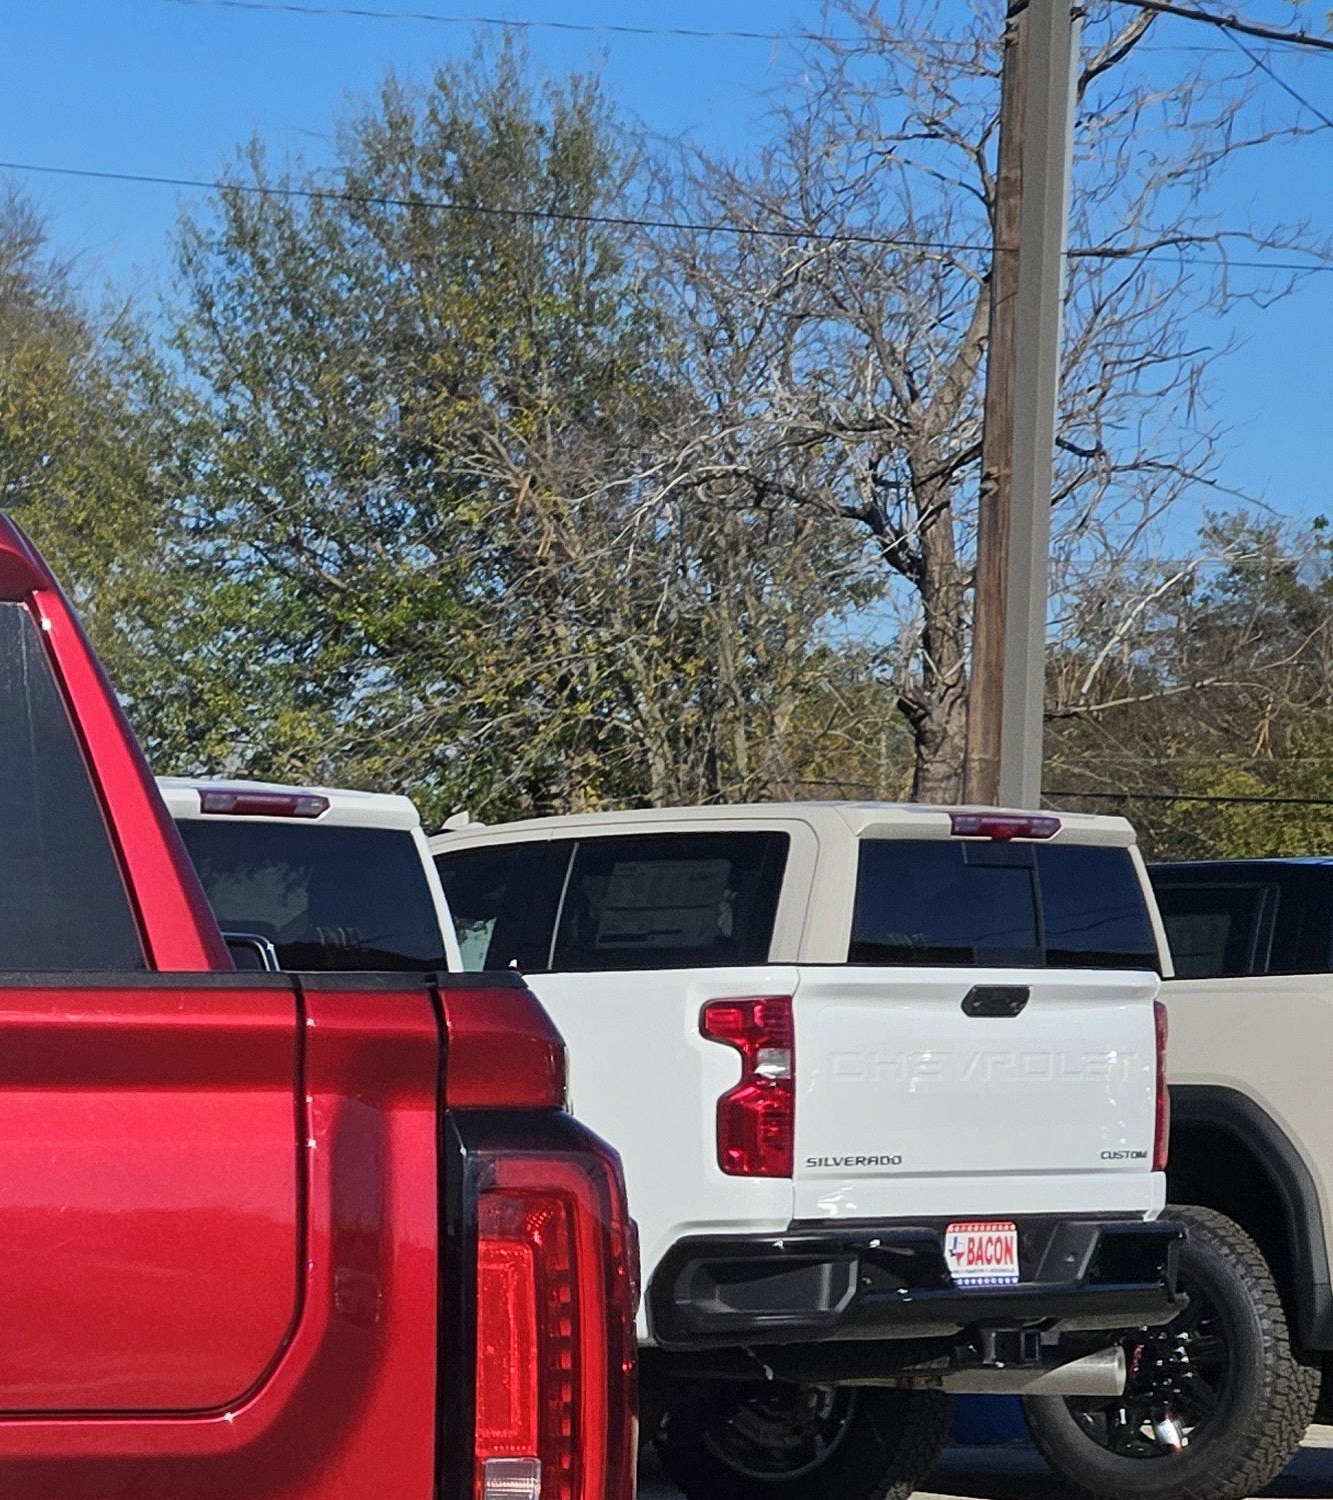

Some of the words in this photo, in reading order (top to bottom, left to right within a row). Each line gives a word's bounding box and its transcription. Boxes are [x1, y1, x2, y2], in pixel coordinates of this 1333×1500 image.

[805, 1154, 902, 1168] SILVERADO
[1100, 1150, 1148, 1160] CUSTOM
[966, 1235, 1014, 1266] BACON
